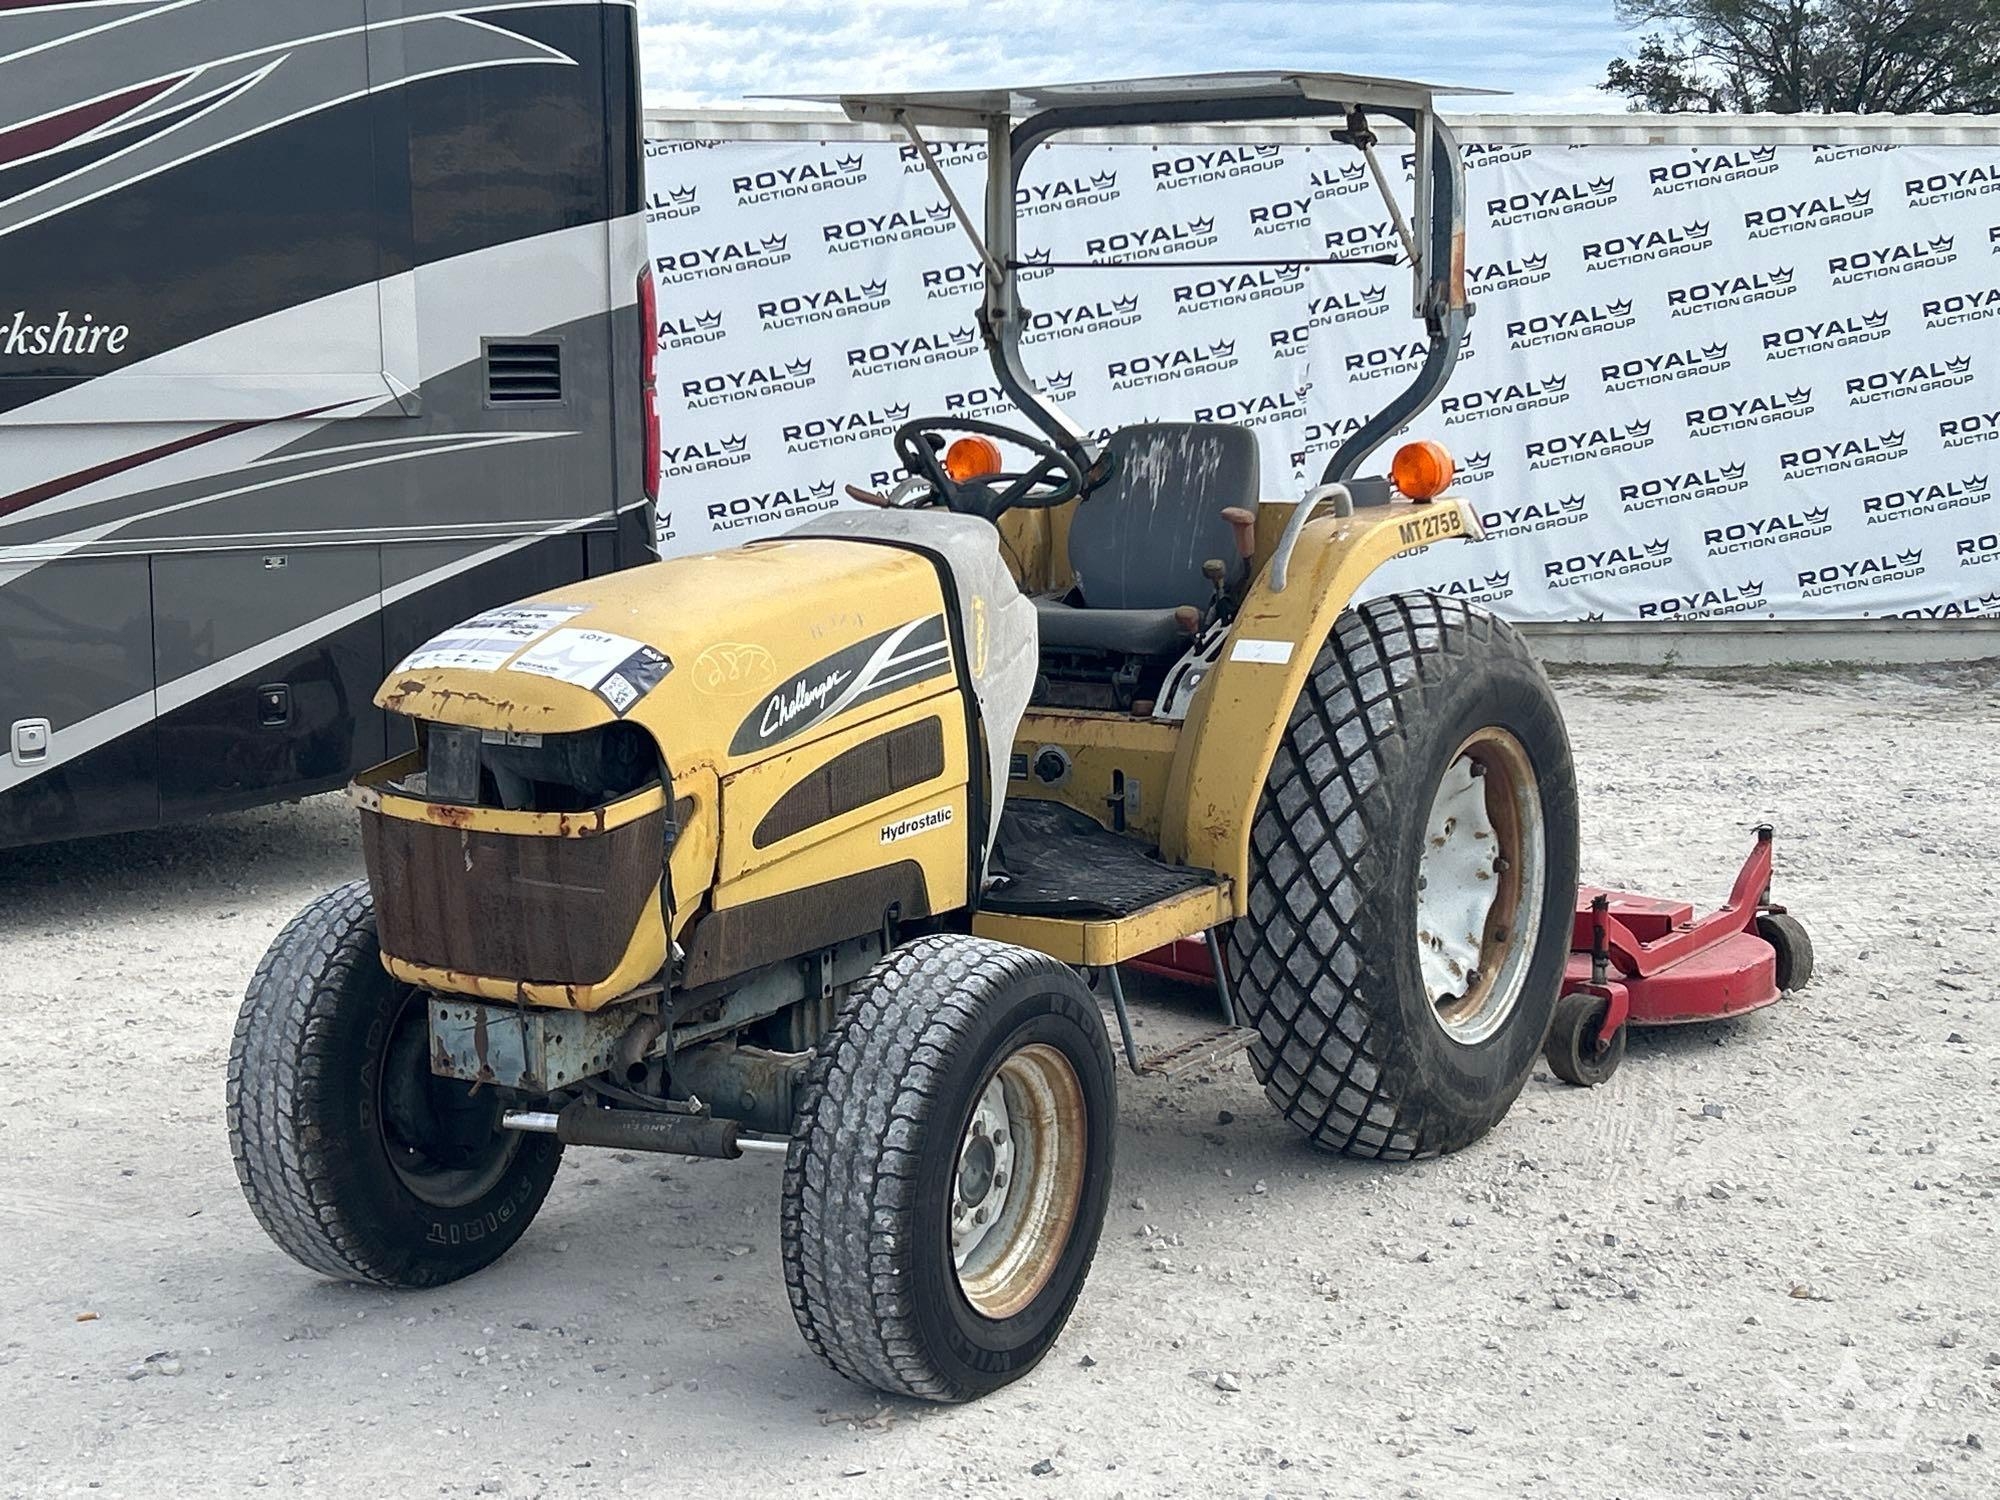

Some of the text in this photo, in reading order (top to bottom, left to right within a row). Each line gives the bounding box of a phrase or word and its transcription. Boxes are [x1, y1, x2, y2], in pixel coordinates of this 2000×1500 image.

[646, 141, 708, 157] UCTION
[904, 153, 973, 174] AUTION
[1152, 147, 1254, 179] ROYAL
[1477, 149, 1532, 168] GROUP
[1815, 145, 1885, 164] AUCTION
[732, 162, 837, 194] ROYAL
[1156, 158, 1284, 191] AUCTION GROUP
[1649, 152, 1750, 184] ROYAL
[1652, 164, 1779, 196] AUCTION GROUP
[738, 174, 867, 206] AUCTION GROUP
[1016, 178, 1091, 204] OYAL
[1016, 190, 1120, 218] CTION GROUP
[1314, 182, 1369, 199] GROUP
[1487, 184, 1588, 216] ROYAL
[1908, 187, 1977, 208] AUCTION
[823, 210, 926, 242] ROYAL
[1250, 197, 1312, 224] ROY
[1254, 217, 1311, 236] AUCTIO
[1491, 196, 1617, 228] AUCTION GROUP
[1744, 196, 1845, 228] ROYAL
[1748, 208, 1874, 240] AUCTION GROUP
[828, 222, 956, 254] AUCTION GROUP
[1086, 224, 1188, 256] ROYAL
[1163, 236, 1218, 254] GROUP
[1582, 228, 1684, 260] ROYAL
[656, 241, 761, 273] ROYAL
[662, 254, 791, 286] AUCTION GROUP
[1466, 261, 1523, 283] YAL
[1586, 240, 1712, 272] AUCTION GROUP
[1829, 242, 1928, 274] ROYAL
[1832, 254, 1957, 286] AUCTION GROUP
[922, 262, 985, 288] ROY
[928, 281, 984, 299] AUCTIO
[1173, 270, 1275, 303] ROYAL
[1497, 272, 1550, 290] GROUP
[1668, 274, 1768, 306] ROYAL
[758, 287, 861, 319] ROYAL
[1178, 282, 1304, 315] AUCTION GROUP
[1308, 293, 1360, 315] YAL
[1335, 304, 1389, 322] GROUP
[1671, 286, 1797, 318] AUCTION GROUP
[1922, 288, 2000, 317] ROYA
[763, 299, 890, 331] AUCTION GROUP
[1087, 314, 1142, 332] GROUP
[1506, 306, 1607, 338] ROYAL
[1925, 308, 1994, 329] AUCTION
[0, 311, 128, 354] kshire
[671, 330, 726, 348] GROUP
[1510, 318, 1636, 350] AUCTION GROUP
[1762, 318, 1862, 349] ROYAL
[1766, 329, 1891, 361] AUCTION GROUP
[847, 334, 950, 366] ROYAL
[852, 346, 978, 378] AUCTION GROUP
[1108, 347, 1210, 379] ROYAL
[1345, 341, 1430, 371] ROYA
[1601, 350, 1702, 382] ROYAL
[682, 366, 786, 398] ROYAL
[1113, 359, 1238, 390] AUCTION GROUP
[1349, 362, 1418, 383] AUCTION
[1605, 361, 1731, 394] AUCTION GROUP
[1846, 363, 1946, 394] ROYAL
[688, 378, 815, 410] AUCTION GROUP
[1441, 382, 1542, 414] ROYAL
[1850, 374, 1974, 406] AUCTION GROUP
[1194, 392, 1296, 423] ROYAL
[1445, 393, 1569, 426] AUCTION GROUP
[1686, 395, 1786, 426] ROYAL
[1689, 406, 1814, 438] AUCTION GROUP
[782, 410, 884, 442] ROYAL
[788, 425, 900, 454] AUCTION GROU
[1939, 411, 2000, 437] ROY
[1943, 431, 1999, 449] AUCTIO
[662, 442, 721, 463] YAL
[1526, 427, 1626, 459] ROYAL
[1530, 438, 1654, 471] AUCTION GROUP
[1780, 438, 1880, 469] ROYAL
[696, 453, 751, 471] GROUP
[1452, 470, 1494, 486] ROUP
[1784, 449, 1908, 481] AUCTION GROUP
[1620, 470, 1720, 501] ROYAL
[1624, 481, 1748, 513] AUCTION GROUP
[1863, 482, 1963, 513] ROYAL
[707, 488, 810, 520] ROYAL
[712, 499, 839, 532] AUCTION GROUP
[1482, 502, 1560, 528] OYAL
[1867, 493, 1991, 526] AUCTION GROUP
[1399, 510, 1460, 545] MT275B
[1535, 513, 1588, 531] GROUP
[1704, 514, 1804, 545] ROYAL
[1707, 525, 1832, 557] AUCTION GROUP
[1544, 546, 1644, 578] ROYAL
[1548, 557, 1672, 590] AUCTION GROUP
[1798, 556, 1897, 587] ROYAL
[1428, 579, 1485, 596] YAL
[1802, 567, 1925, 598] AUCTION GROUP
[1638, 588, 1738, 619] ROYAL
[1713, 599, 1767, 616] GROUP
[760, 670, 851, 737] Challenger
[881, 808, 953, 841] Hydrostatic
